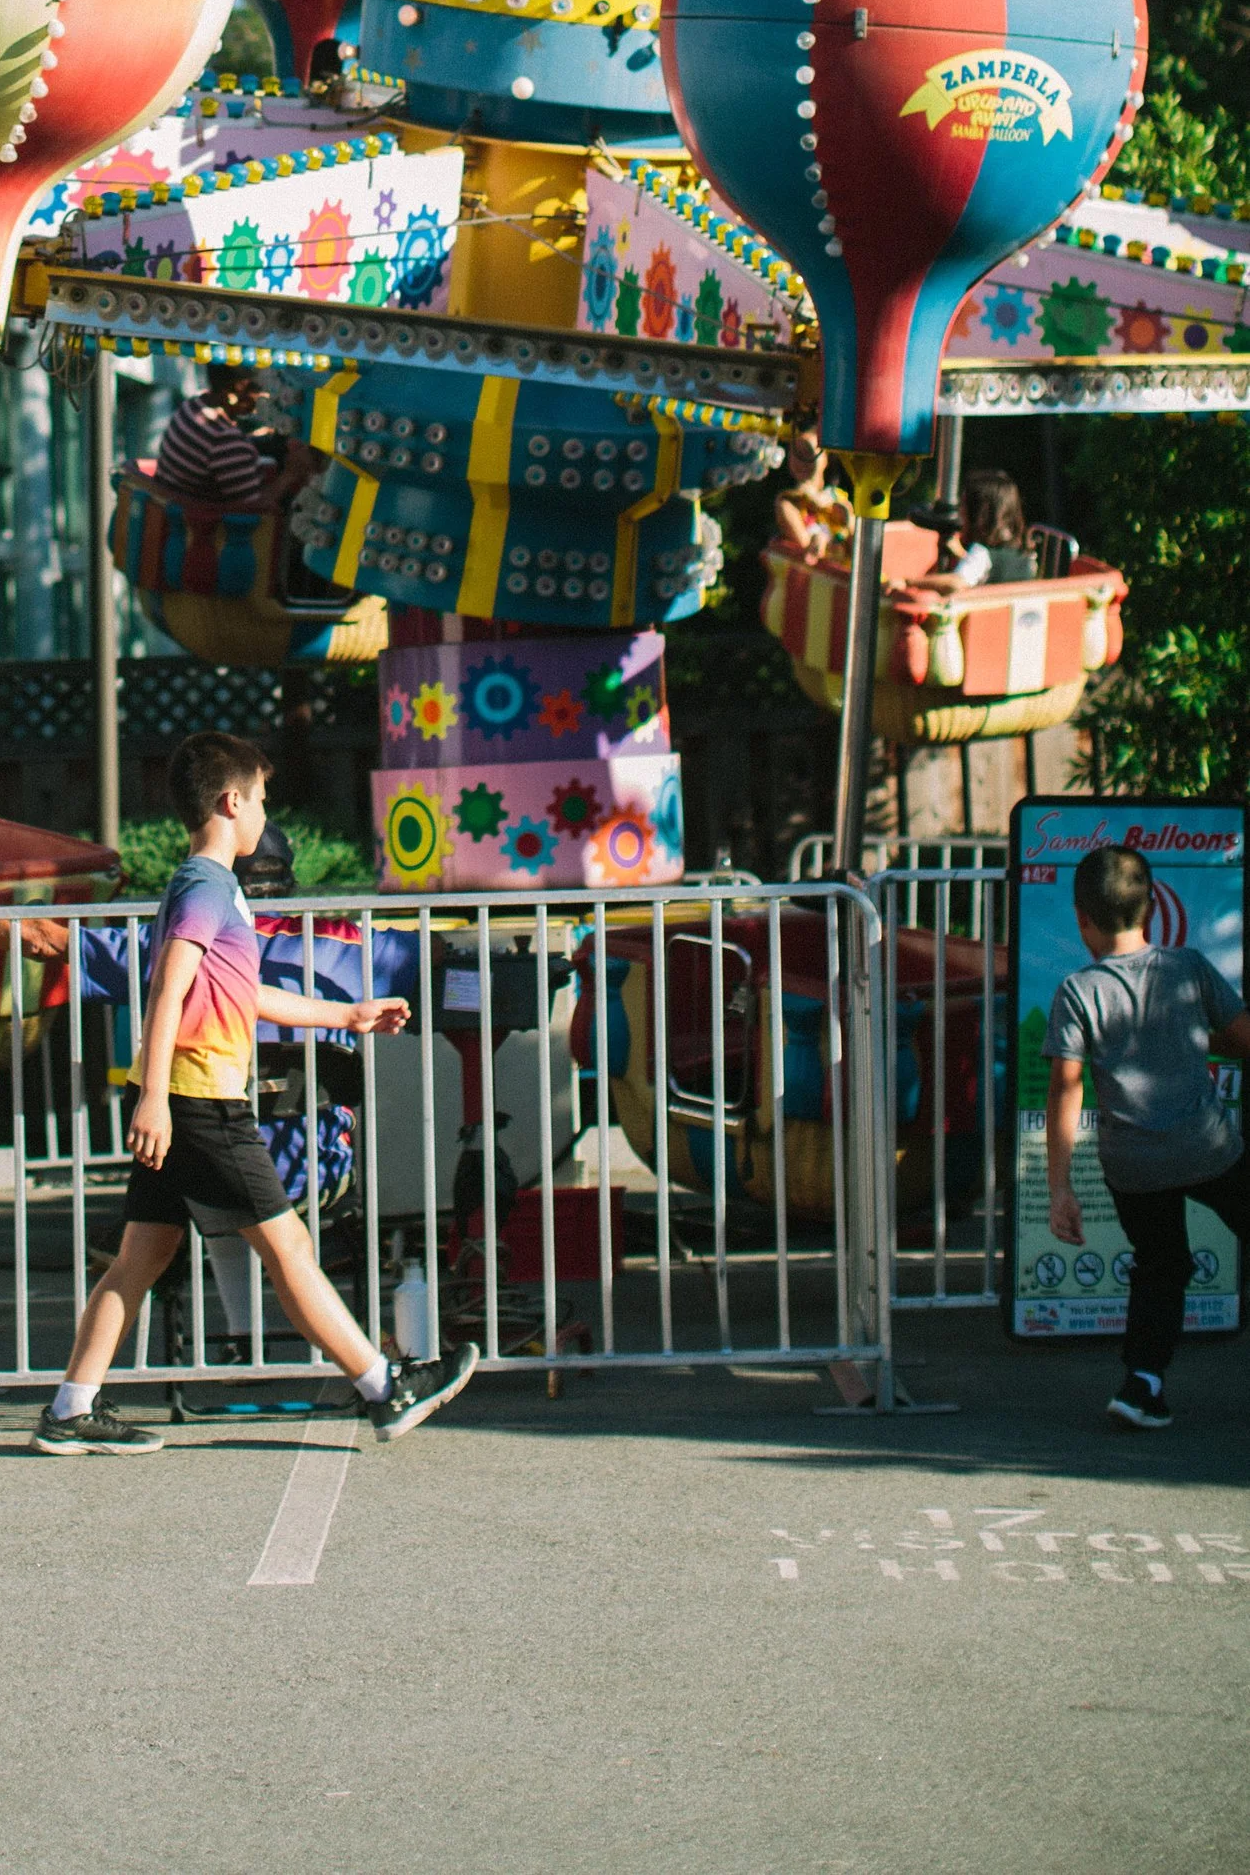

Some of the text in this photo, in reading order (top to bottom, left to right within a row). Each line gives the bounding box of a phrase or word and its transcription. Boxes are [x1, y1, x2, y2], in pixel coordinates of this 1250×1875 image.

[941, 60, 1061, 107] ZAMPERLA
[1002, 96, 1038, 118] AND
[1123, 824, 1238, 852] Balloons
[917, 1508, 1047, 1528] 17
